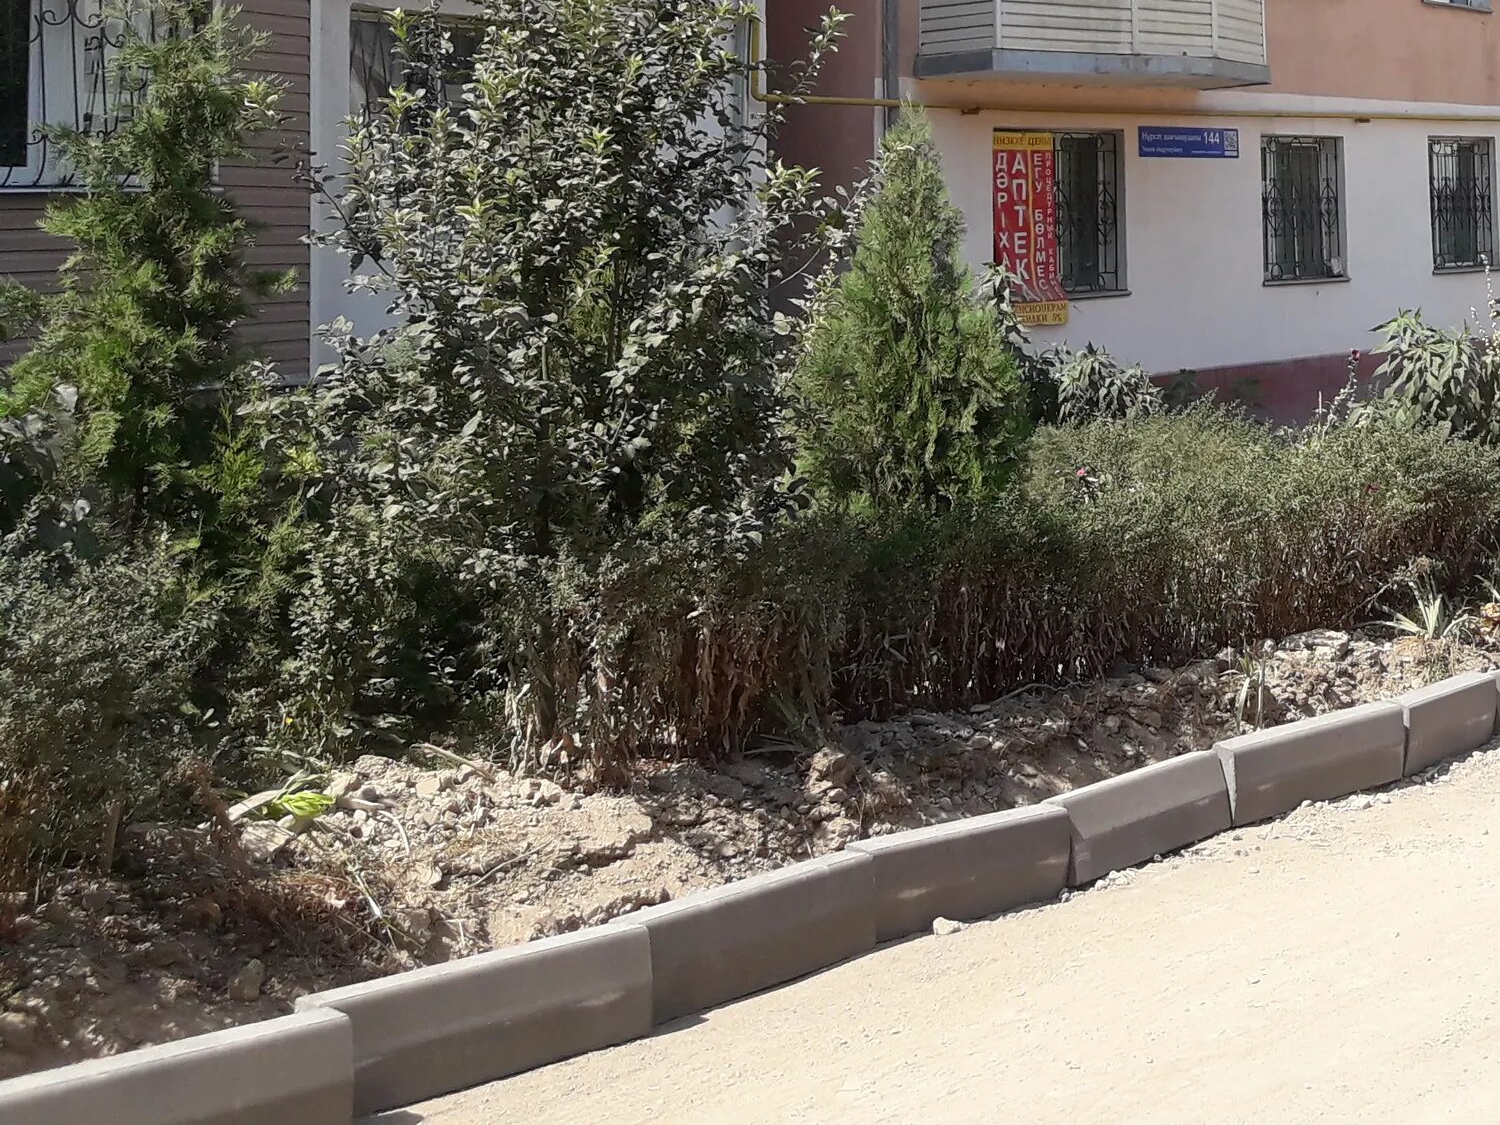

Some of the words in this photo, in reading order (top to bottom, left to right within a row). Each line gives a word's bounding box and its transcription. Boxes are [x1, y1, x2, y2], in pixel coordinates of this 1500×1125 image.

[1203, 131, 1220, 145] 144
[1033, 153, 1043, 193] ЕГУ
[1011, 153, 1040, 302] АПТЕКА
[1013, 302, 1067, 314] ЕНСИОНЕРАМ
